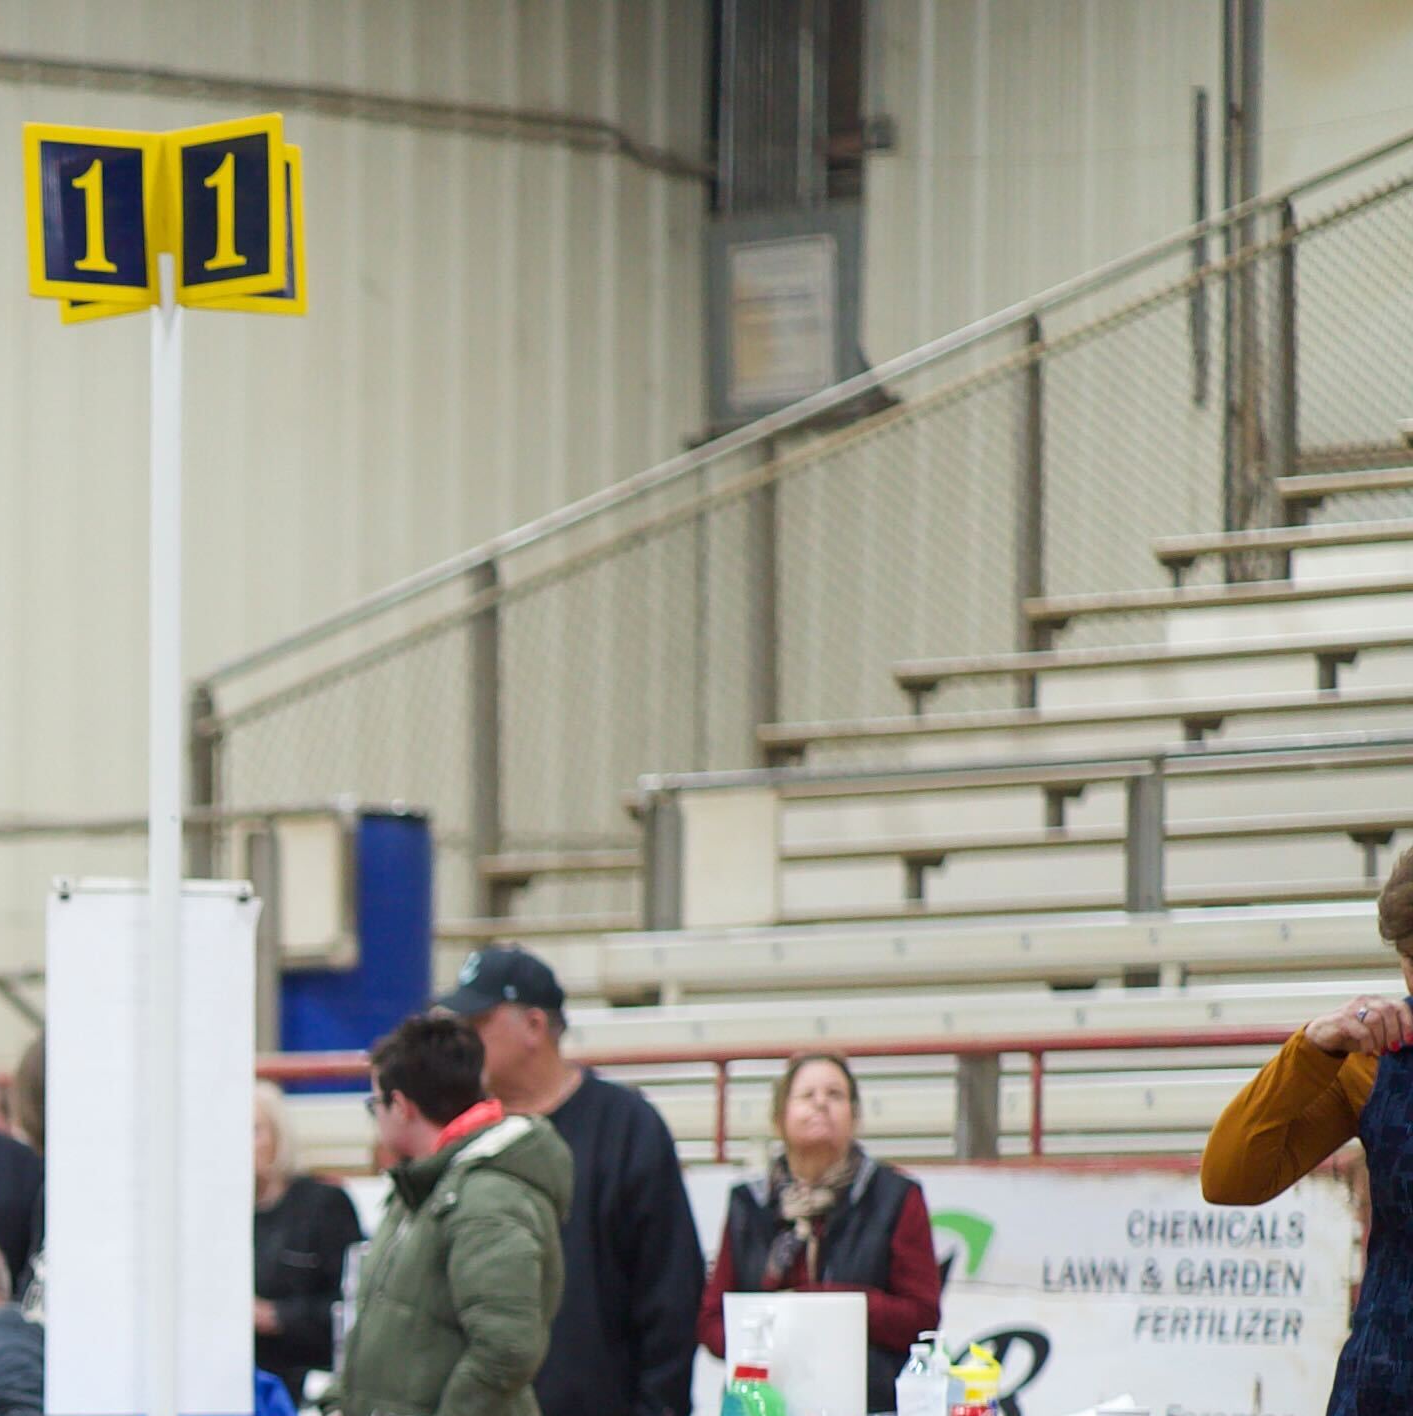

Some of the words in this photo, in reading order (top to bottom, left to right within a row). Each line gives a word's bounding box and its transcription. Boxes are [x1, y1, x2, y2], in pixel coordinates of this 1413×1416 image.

[71, 157, 118, 274] 1
[204, 151, 248, 272] 1
[1126, 1209, 1305, 1249] CHEMICALS
[1041, 1256, 1128, 1293] LAWN
[1140, 1256, 1162, 1293] &
[1175, 1257, 1305, 1296] GARDEN
[1133, 1305, 1304, 1345] FERTILIZER
